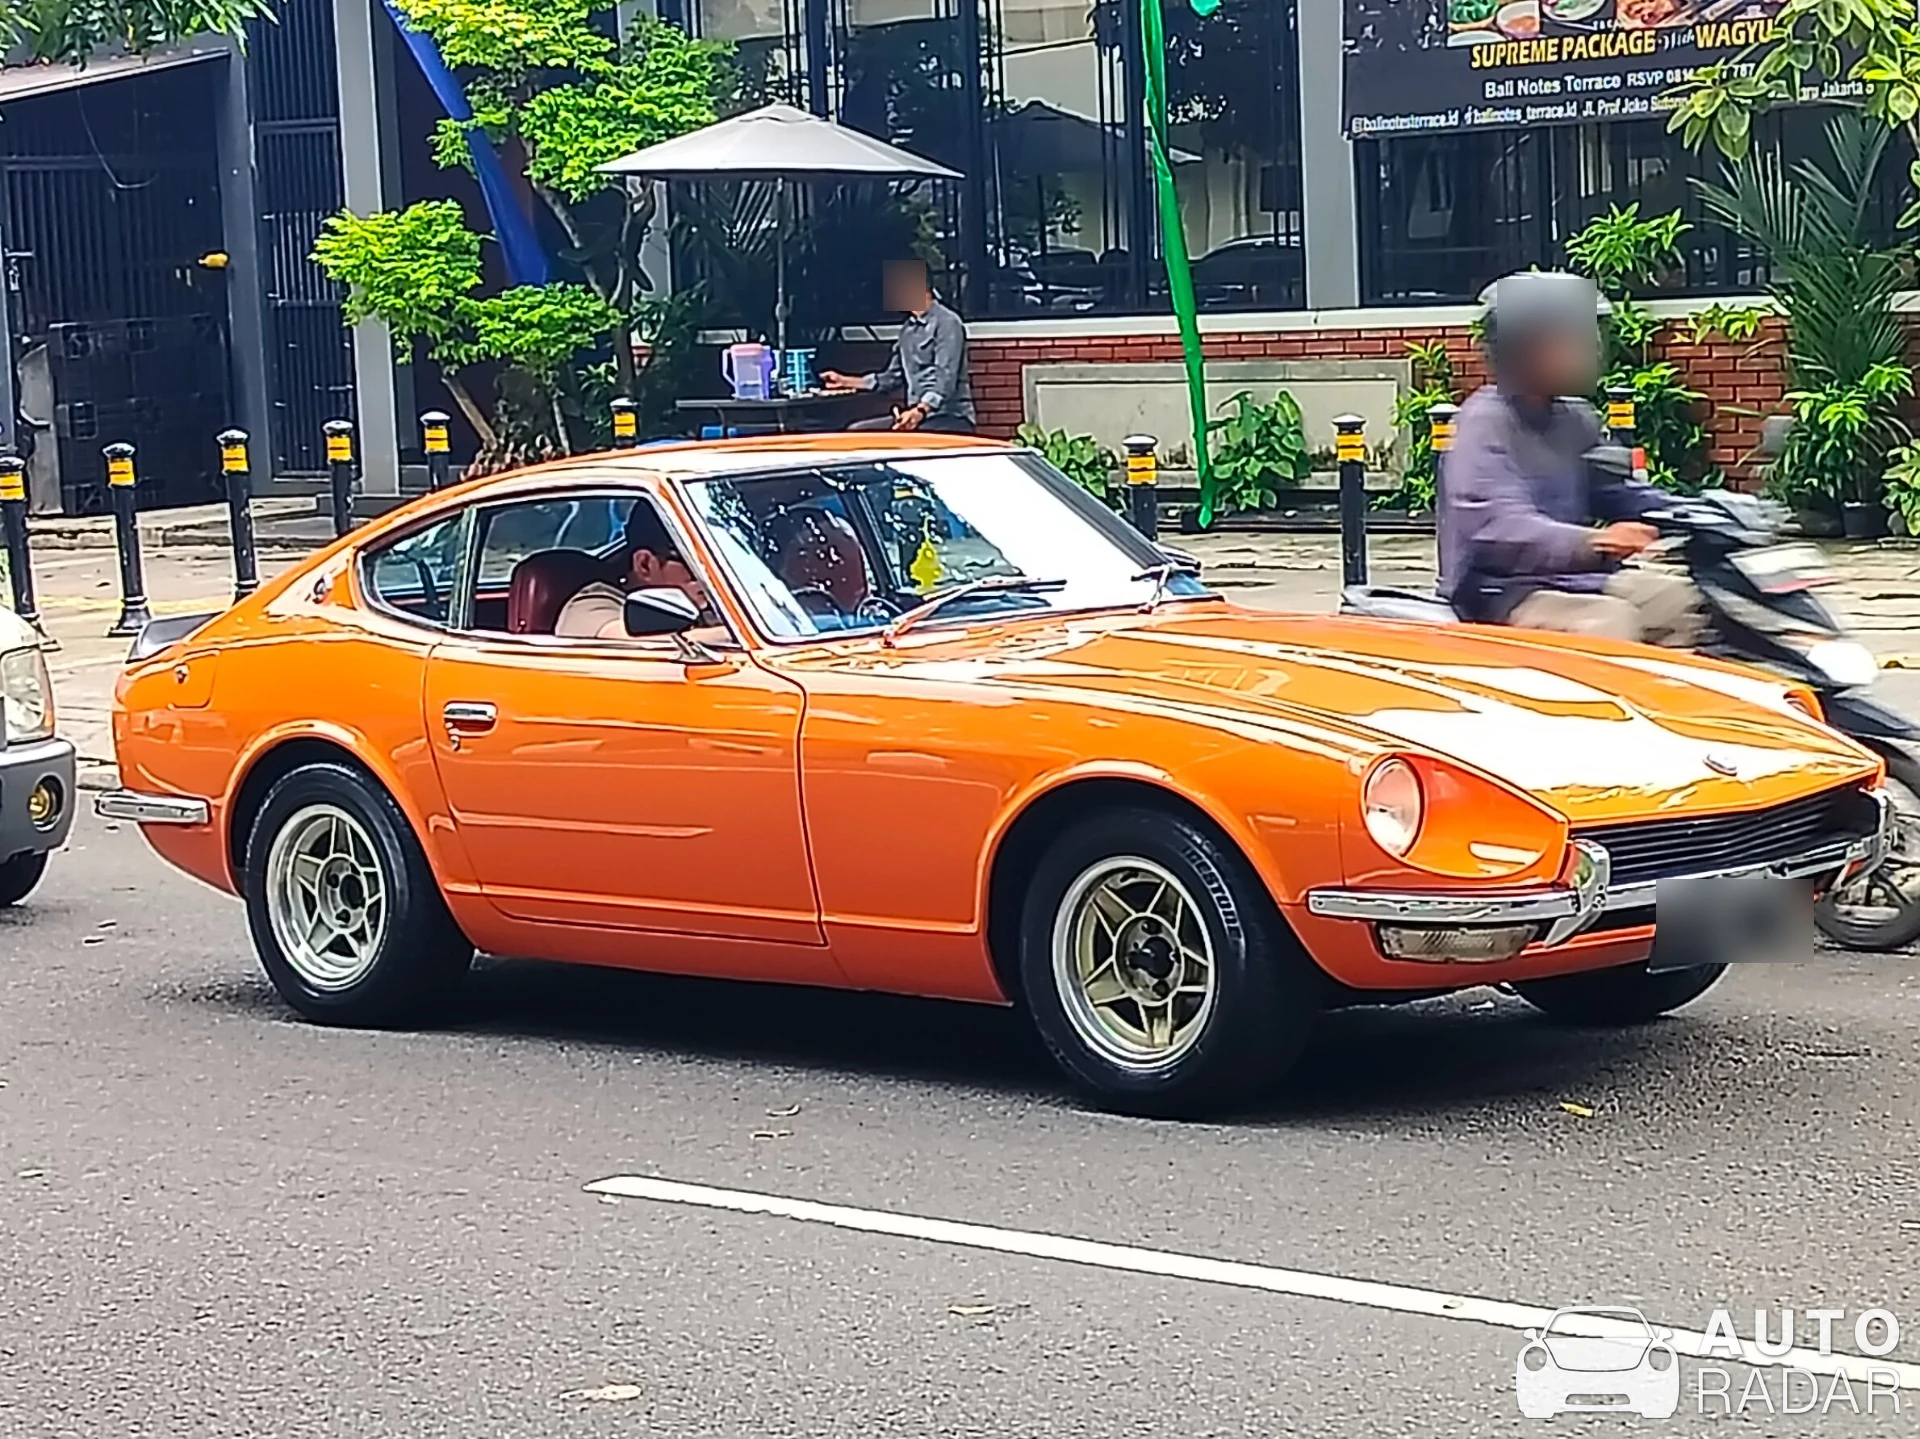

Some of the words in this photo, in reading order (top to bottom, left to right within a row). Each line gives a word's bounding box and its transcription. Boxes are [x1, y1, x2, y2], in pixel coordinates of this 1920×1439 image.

[1471, 38, 1559, 68] SUPREME
[1562, 29, 1656, 61] PACKAGE
[1695, 18, 1774, 49] WAGYU
[1517, 77, 1561, 96] Notes
[1627, 72, 1664, 87] RSVP
[1822, 81, 1863, 98] Jakarta
